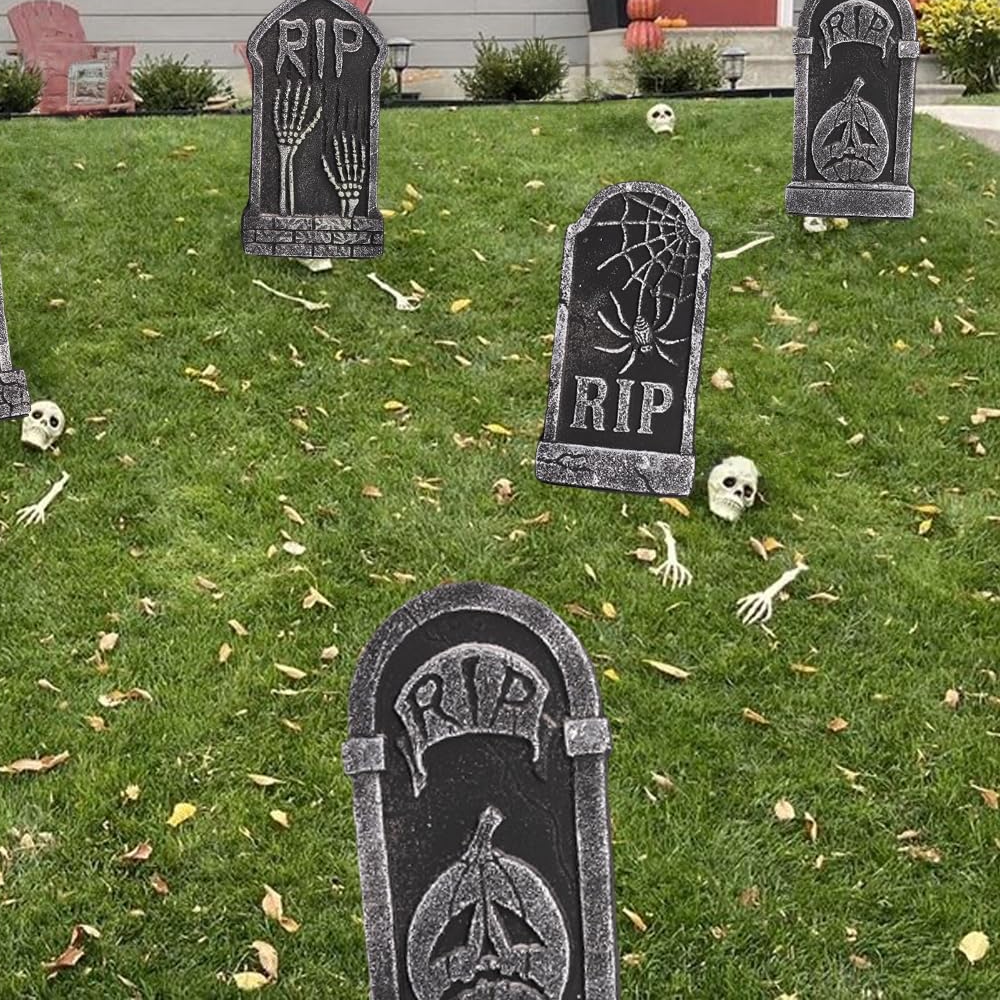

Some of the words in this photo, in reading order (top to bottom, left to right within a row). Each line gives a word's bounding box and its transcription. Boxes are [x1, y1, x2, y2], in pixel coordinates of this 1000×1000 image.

[276, 18, 363, 79] RIP
[827, 5, 888, 43] RIP
[570, 375, 673, 434] RIP
[406, 655, 537, 743] RIP
